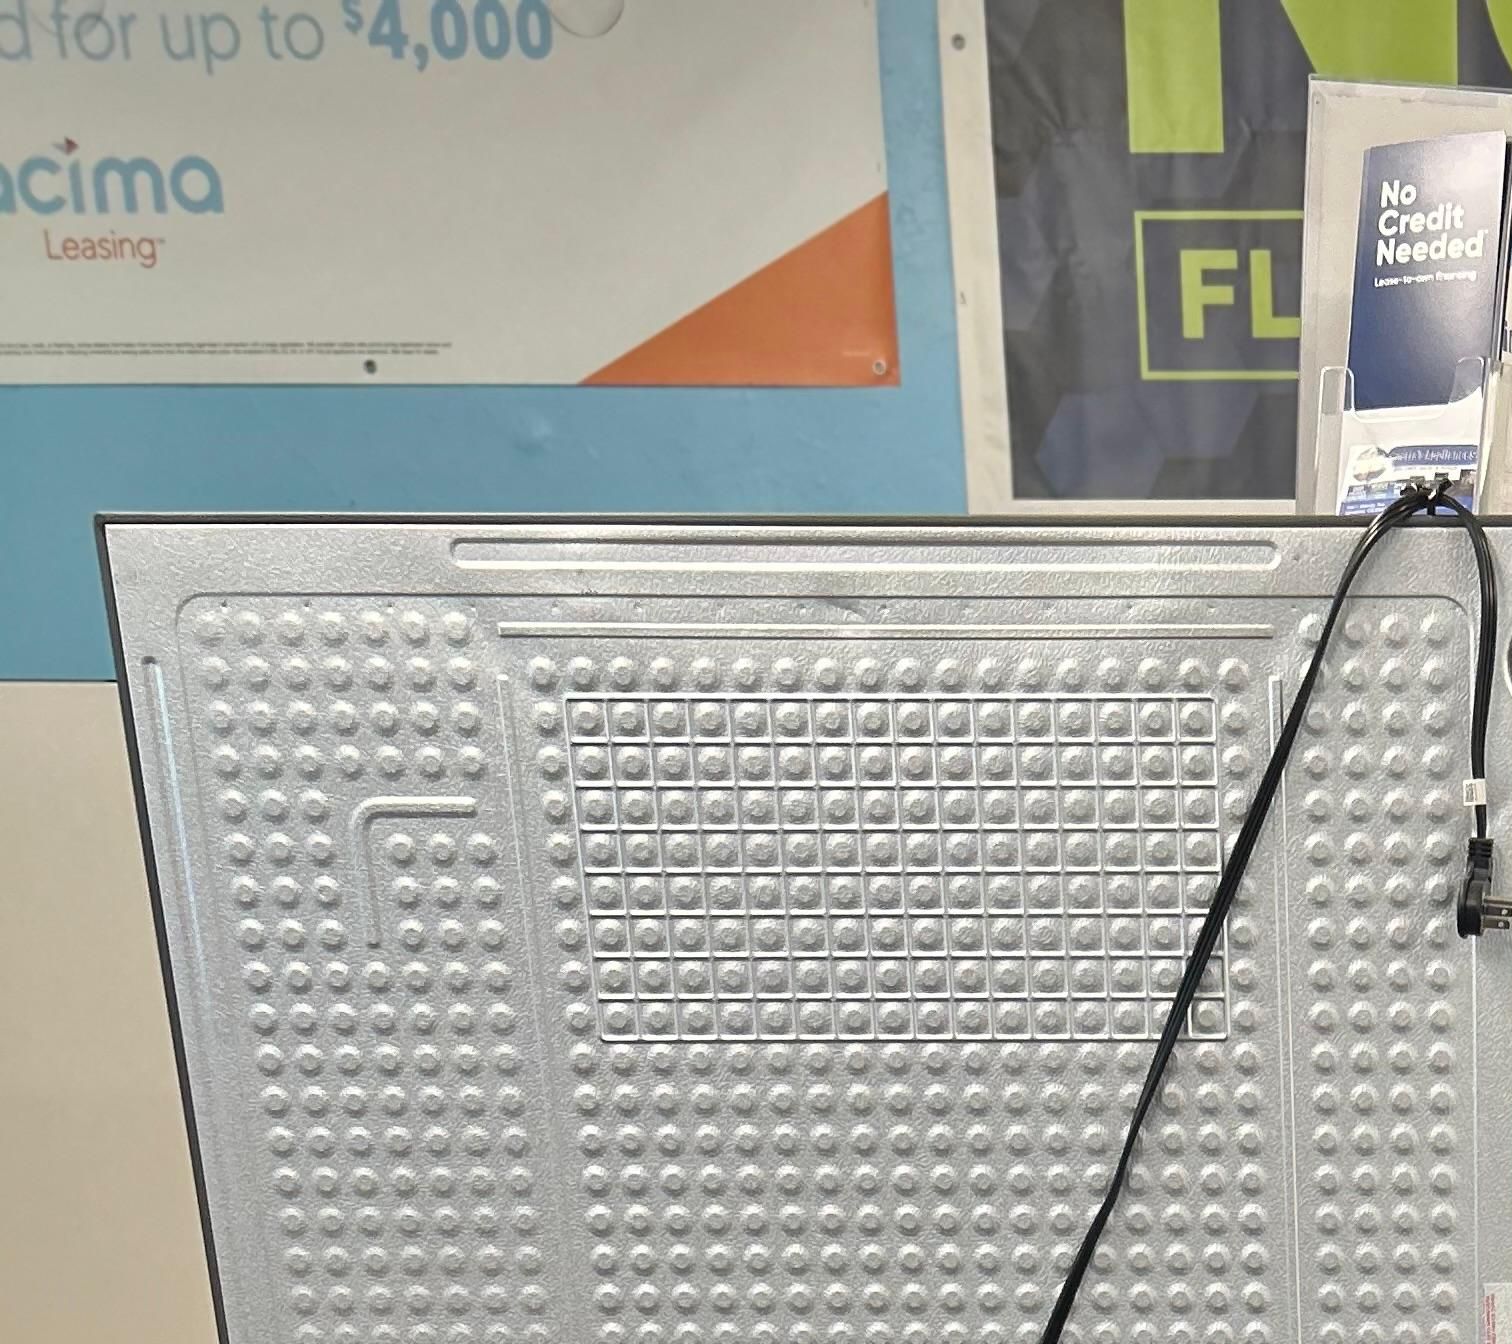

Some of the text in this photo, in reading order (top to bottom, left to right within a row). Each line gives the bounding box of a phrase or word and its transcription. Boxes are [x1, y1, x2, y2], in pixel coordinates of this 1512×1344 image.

[53, 0, 136, 61] for
[162, 12, 241, 76] up
[263, 5, 324, 61] to
[344, 0, 554, 71] $4,000
[1380, 180, 1417, 208] No
[1378, 202, 1465, 236] Credit
[43, 229, 157, 269] Leasing
[1376, 229, 1486, 267] Needed
